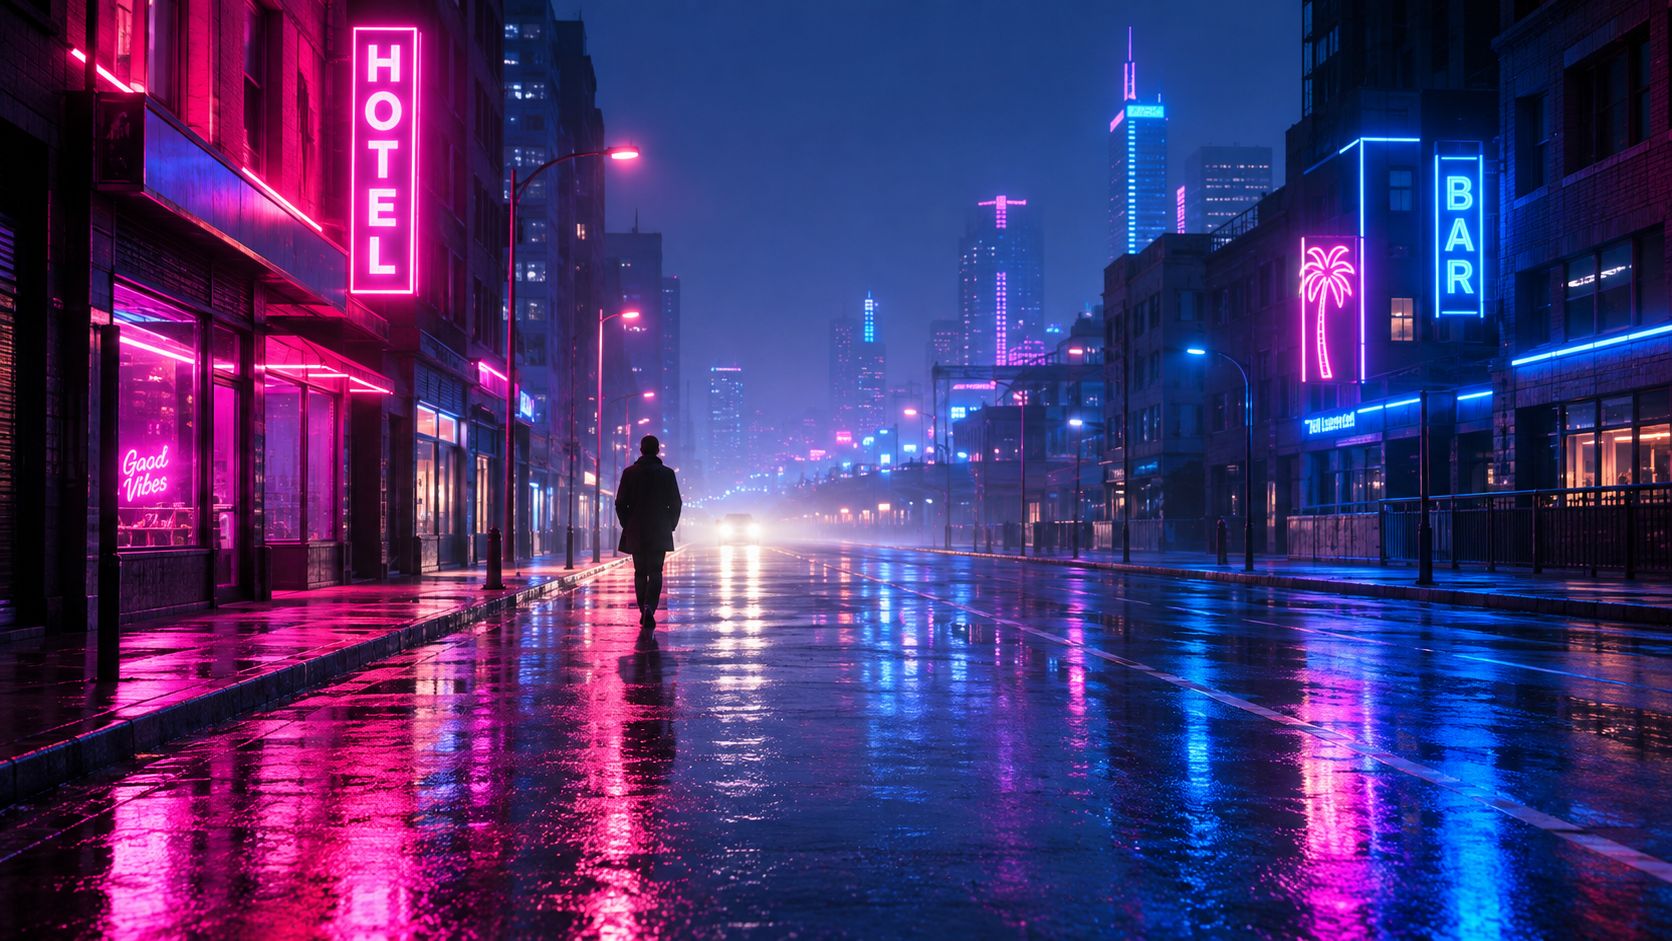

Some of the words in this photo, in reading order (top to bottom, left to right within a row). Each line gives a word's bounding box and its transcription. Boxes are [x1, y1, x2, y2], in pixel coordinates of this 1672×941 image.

[365, 44, 402, 275] HOTEL
[1445, 175, 1475, 294] BAR
[123, 472, 168, 503] Vibes
